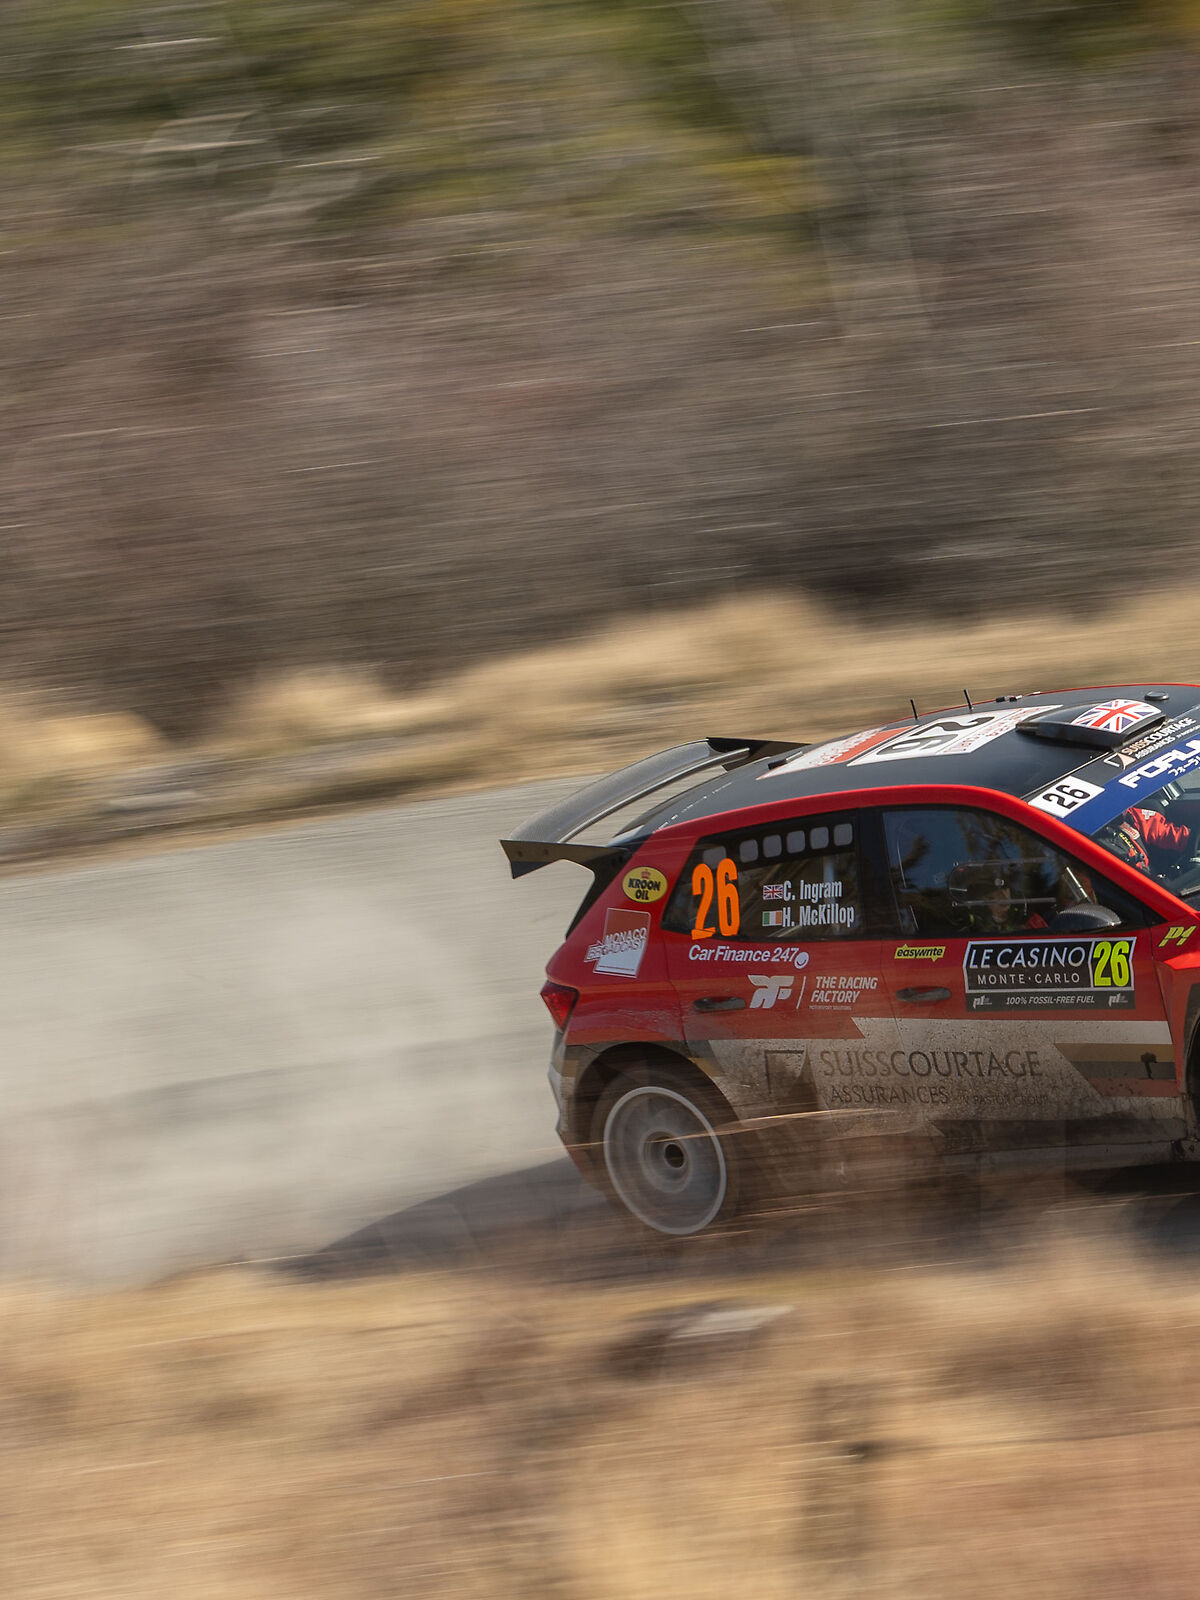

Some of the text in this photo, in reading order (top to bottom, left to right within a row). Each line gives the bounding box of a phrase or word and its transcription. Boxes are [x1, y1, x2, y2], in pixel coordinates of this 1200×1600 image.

[1042, 784, 1091, 810] 26
[635, 890, 649, 900] OIL
[691, 858, 740, 940] 26
[783, 880, 843, 903] C. Ingram
[782, 904, 855, 927] H. McKillop
[771, 947, 799, 962] 247
[969, 946, 1086, 969] LE CASINO
[1093, 941, 1130, 987] 26
[816, 976, 878, 990] THE RACING
[811, 990, 860, 1003] FACTORY
[1006, 996, 1027, 1005] 100%
[1076, 995, 1095, 1004] FUEL
[819, 1050, 1043, 1078] SUISSCOURTAGE
[830, 1086, 949, 1105] ASSURANCES
